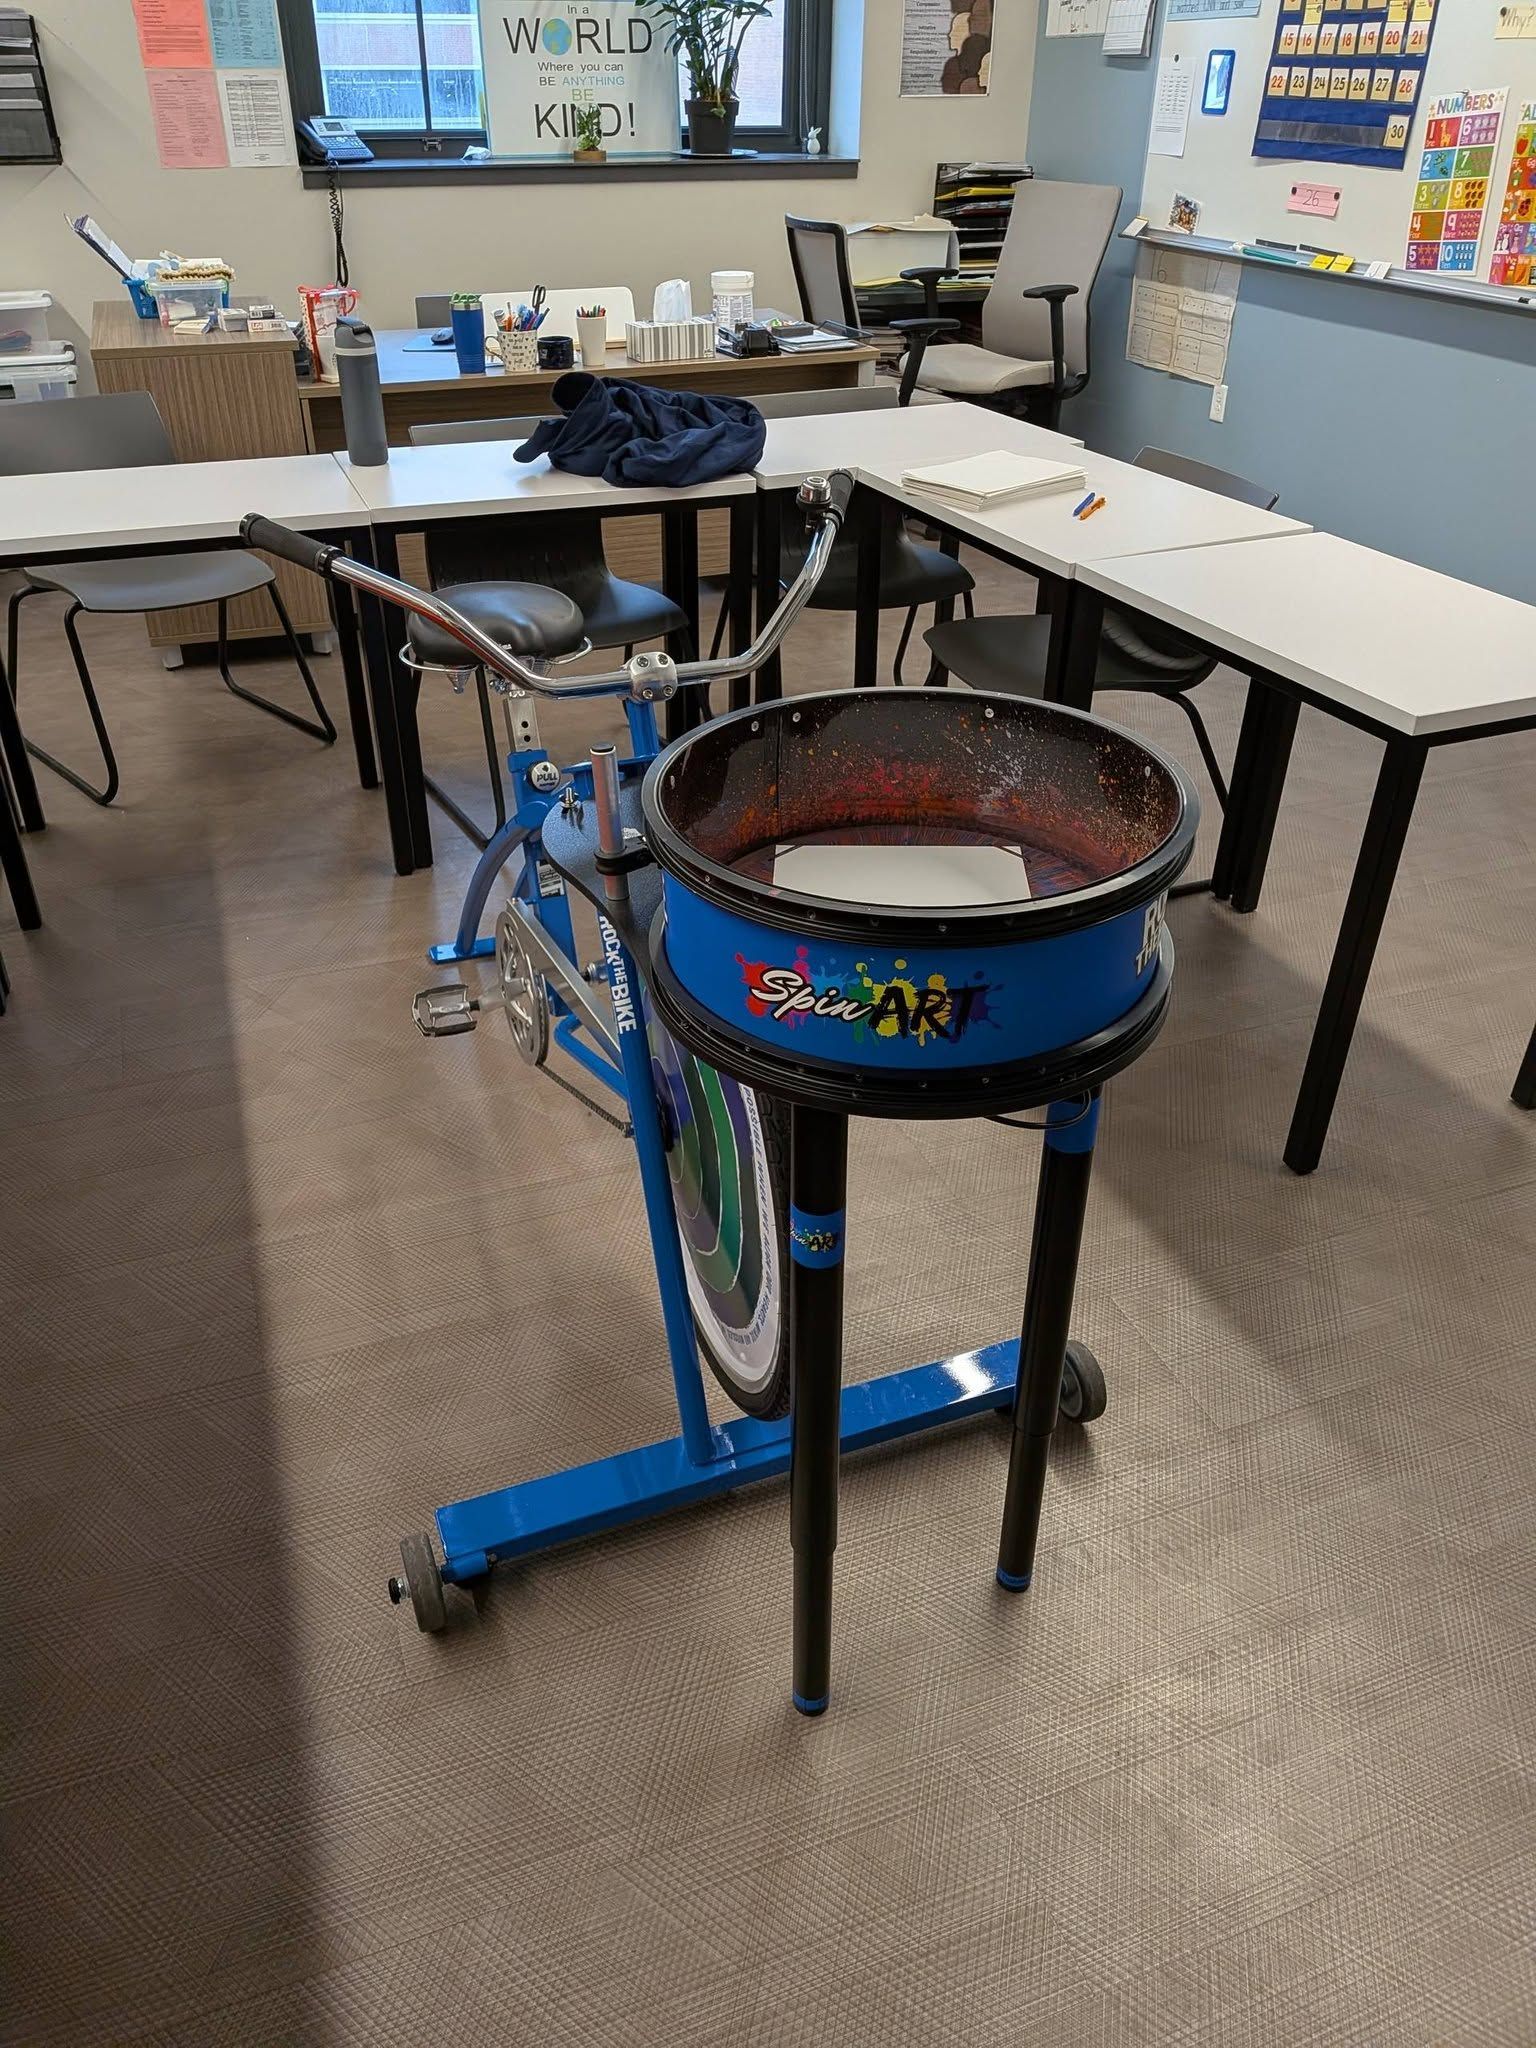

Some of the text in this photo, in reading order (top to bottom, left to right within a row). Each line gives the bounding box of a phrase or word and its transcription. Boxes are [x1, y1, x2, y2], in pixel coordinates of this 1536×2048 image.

[568, 5, 577, 14] In
[503, 18, 653, 55] WORLD
[1283, 30, 1423, 46] 15 16 17 18 19 20 21
[538, 62, 624, 74] Where you can
[539, 76, 625, 86] BE ANYTHING
[1271, 75, 1413, 93] 22 23 24 25 26 27 28
[572, 89, 594, 101] BE
[1437, 94, 1495, 114] NUMBERS
[1391, 125, 1404, 139] 30
[1429, 121, 1436, 139] 1
[1462, 118, 1472, 136] 6
[1422, 153, 1431, 171] 2
[1461, 151, 1470, 168] 7
[1302, 189, 1320, 208] 26
[1419, 185, 1427, 201] 3
[1454, 182, 1463, 199] 8
[1413, 215, 1421, 231] 4
[1448, 214, 1457, 230] 9
[1408, 245, 1417, 262] 5
[1441, 245, 1454, 262] 10
[536, 773, 558, 782] PULL
[612, 985, 637, 1035] BIKE
